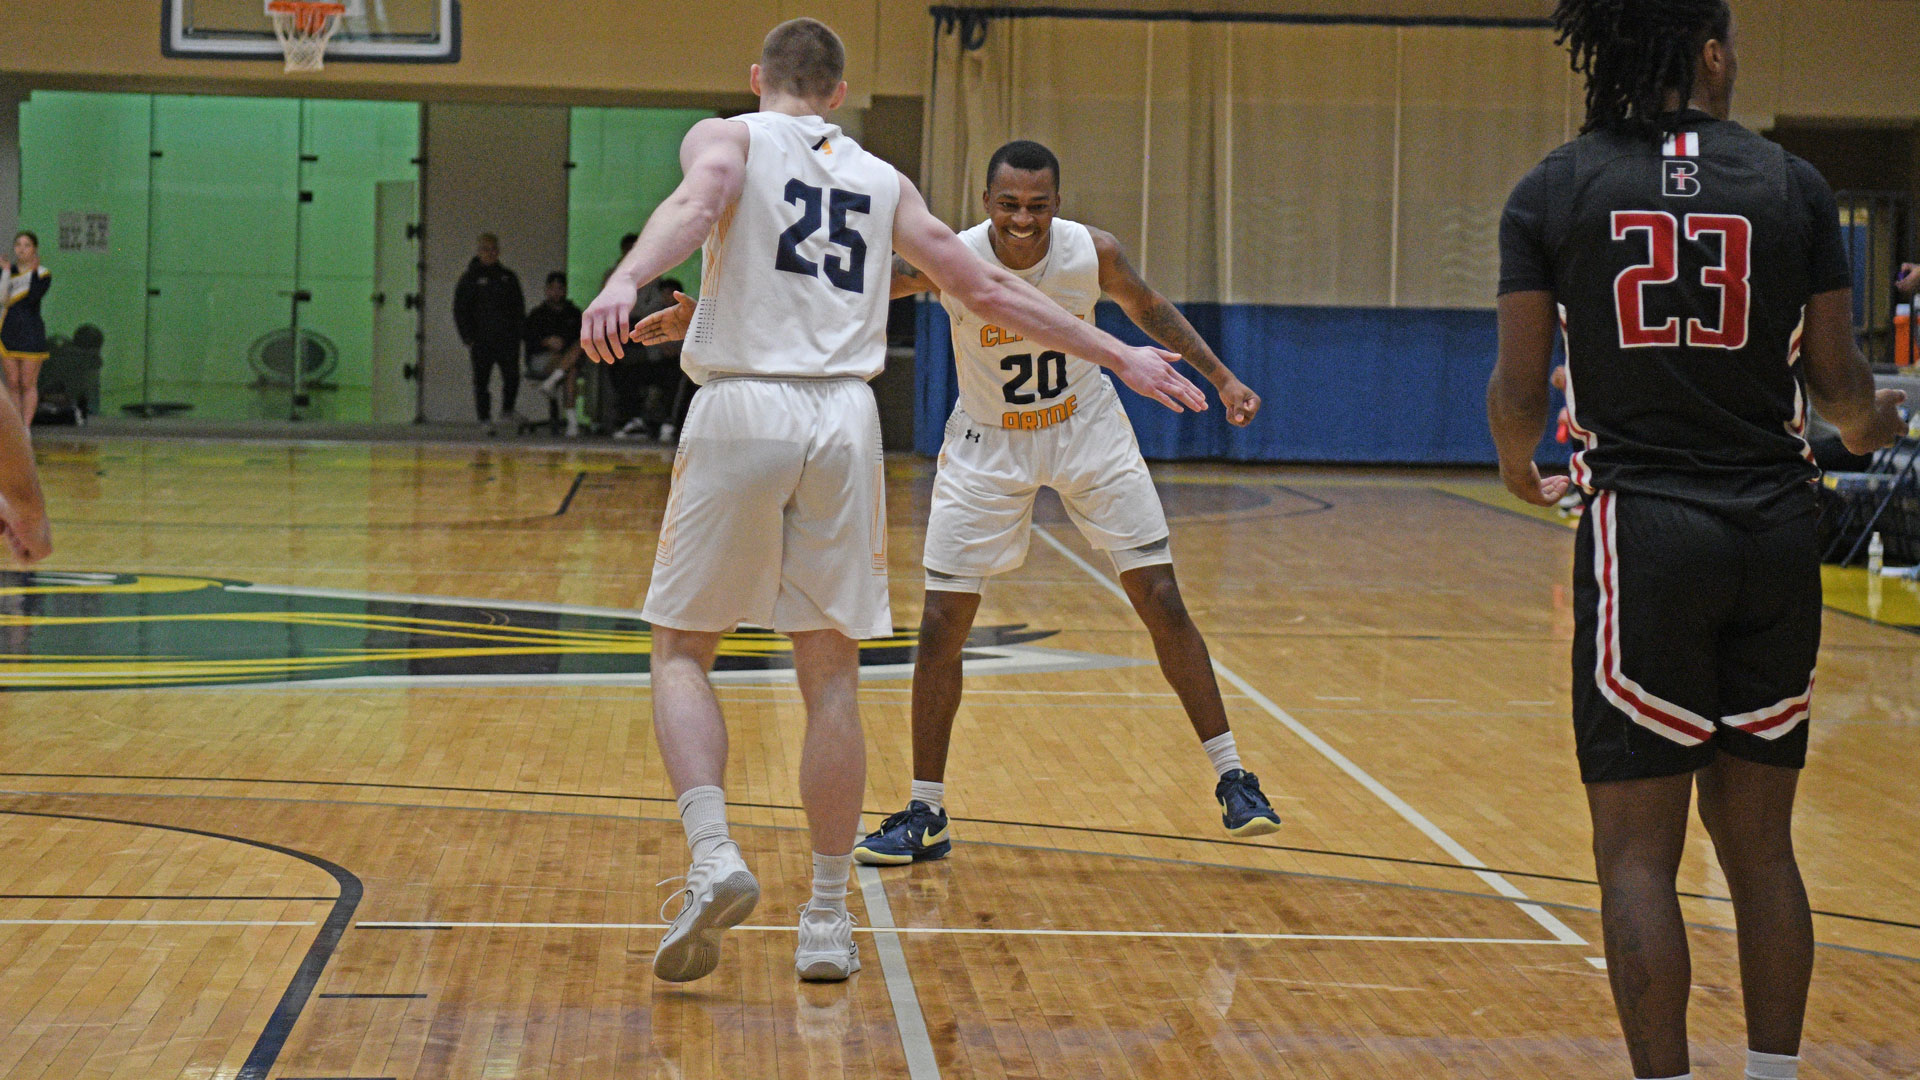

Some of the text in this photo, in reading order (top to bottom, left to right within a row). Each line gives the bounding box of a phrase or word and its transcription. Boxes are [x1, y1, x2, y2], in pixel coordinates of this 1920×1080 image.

[775, 177, 871, 294] 25
[1610, 210, 1752, 350] 23
[1000, 350, 1068, 405] 20
